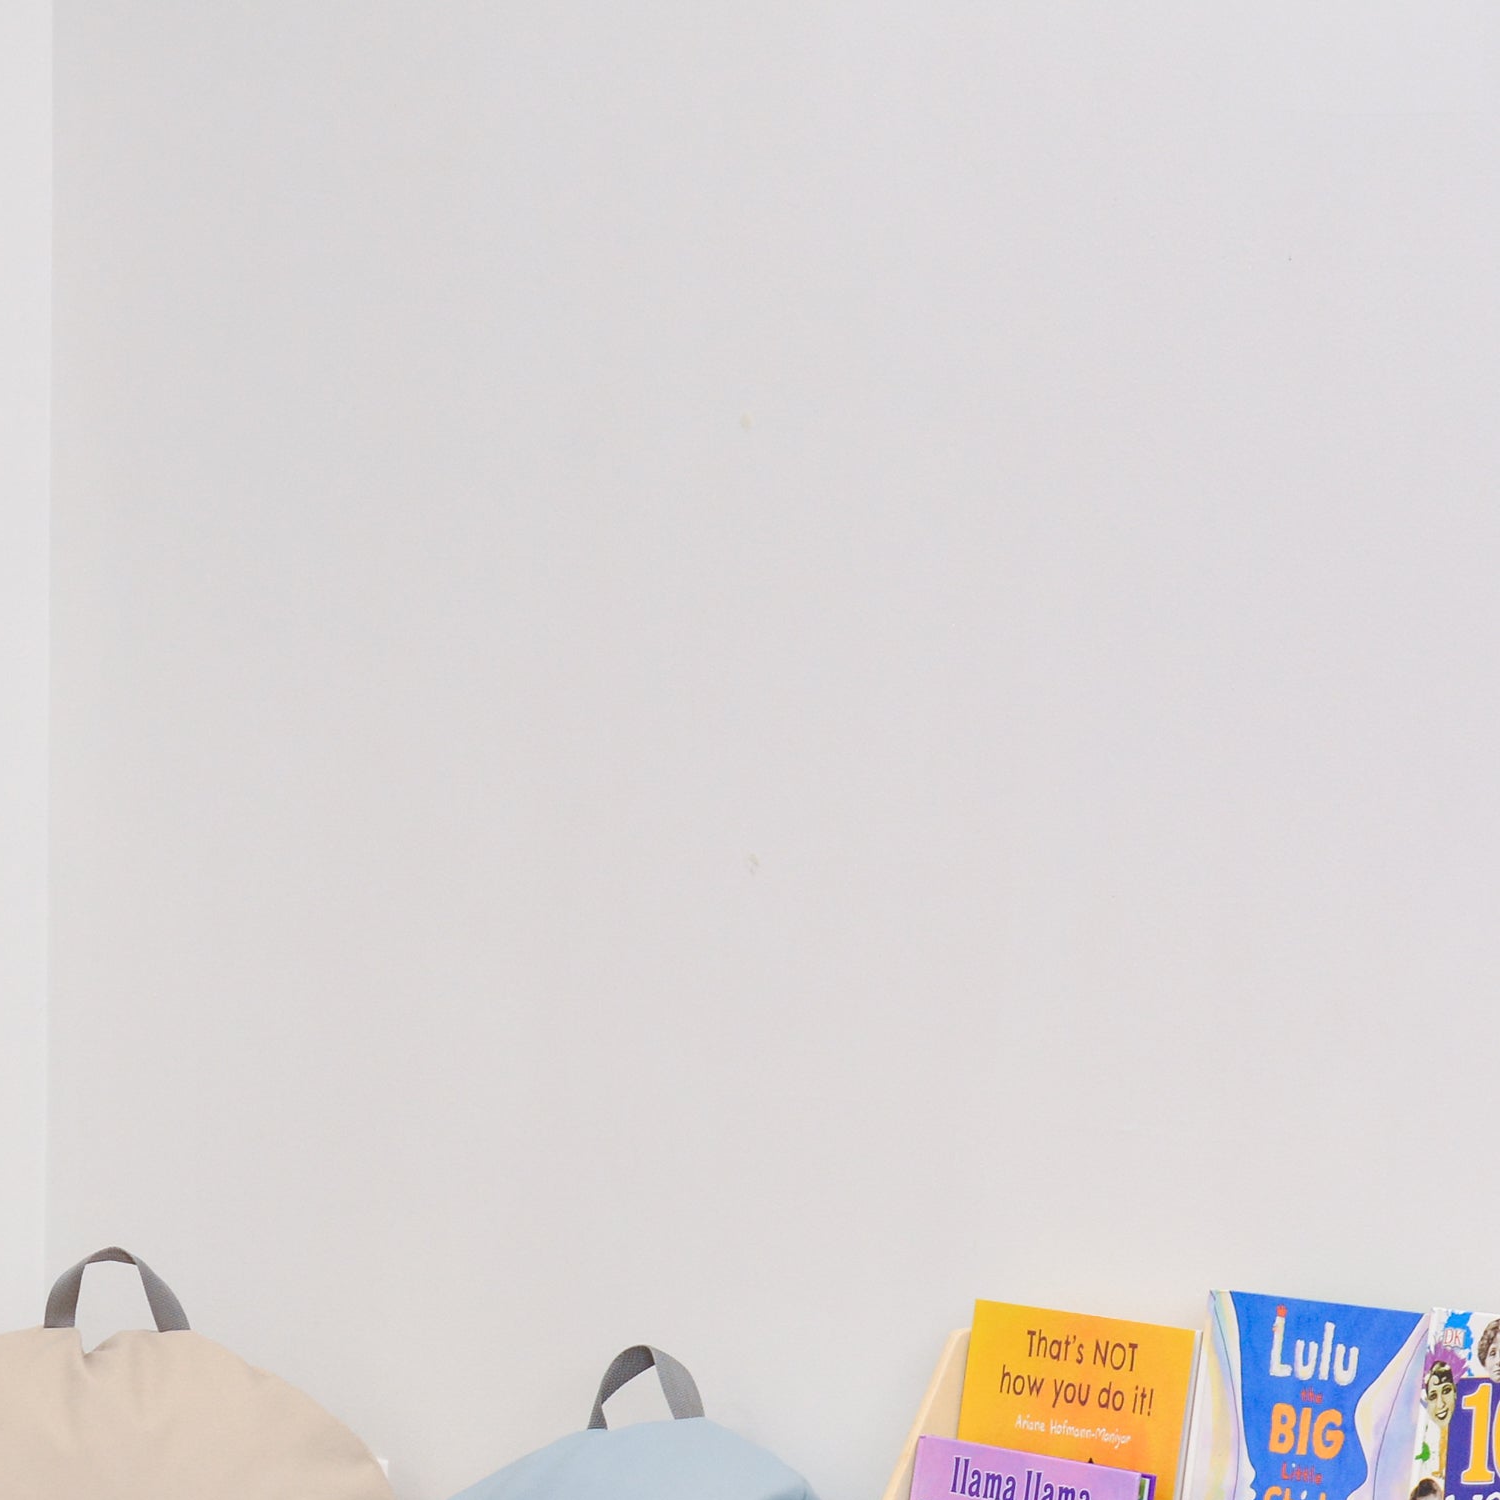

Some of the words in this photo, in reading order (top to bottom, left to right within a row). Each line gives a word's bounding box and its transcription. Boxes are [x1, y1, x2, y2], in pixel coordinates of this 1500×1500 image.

[1269, 1308, 1359, 1385] Lulu
[1444, 1328, 1463, 1346] DK
[1093, 1339, 1138, 1372] NOT
[999, 1364, 1045, 1398] how
[1051, 1378, 1091, 1408] you
[1098, 1381, 1125, 1411] do
[1132, 1384, 1155, 1416] it!
[1300, 1386, 1323, 1404] the
[1014, 1413, 1045, 1433] Ariane
[1269, 1402, 1345, 1460] BIG
[1461, 1383, 1500, 1485] 1
[1281, 1462, 1323, 1485] Little
